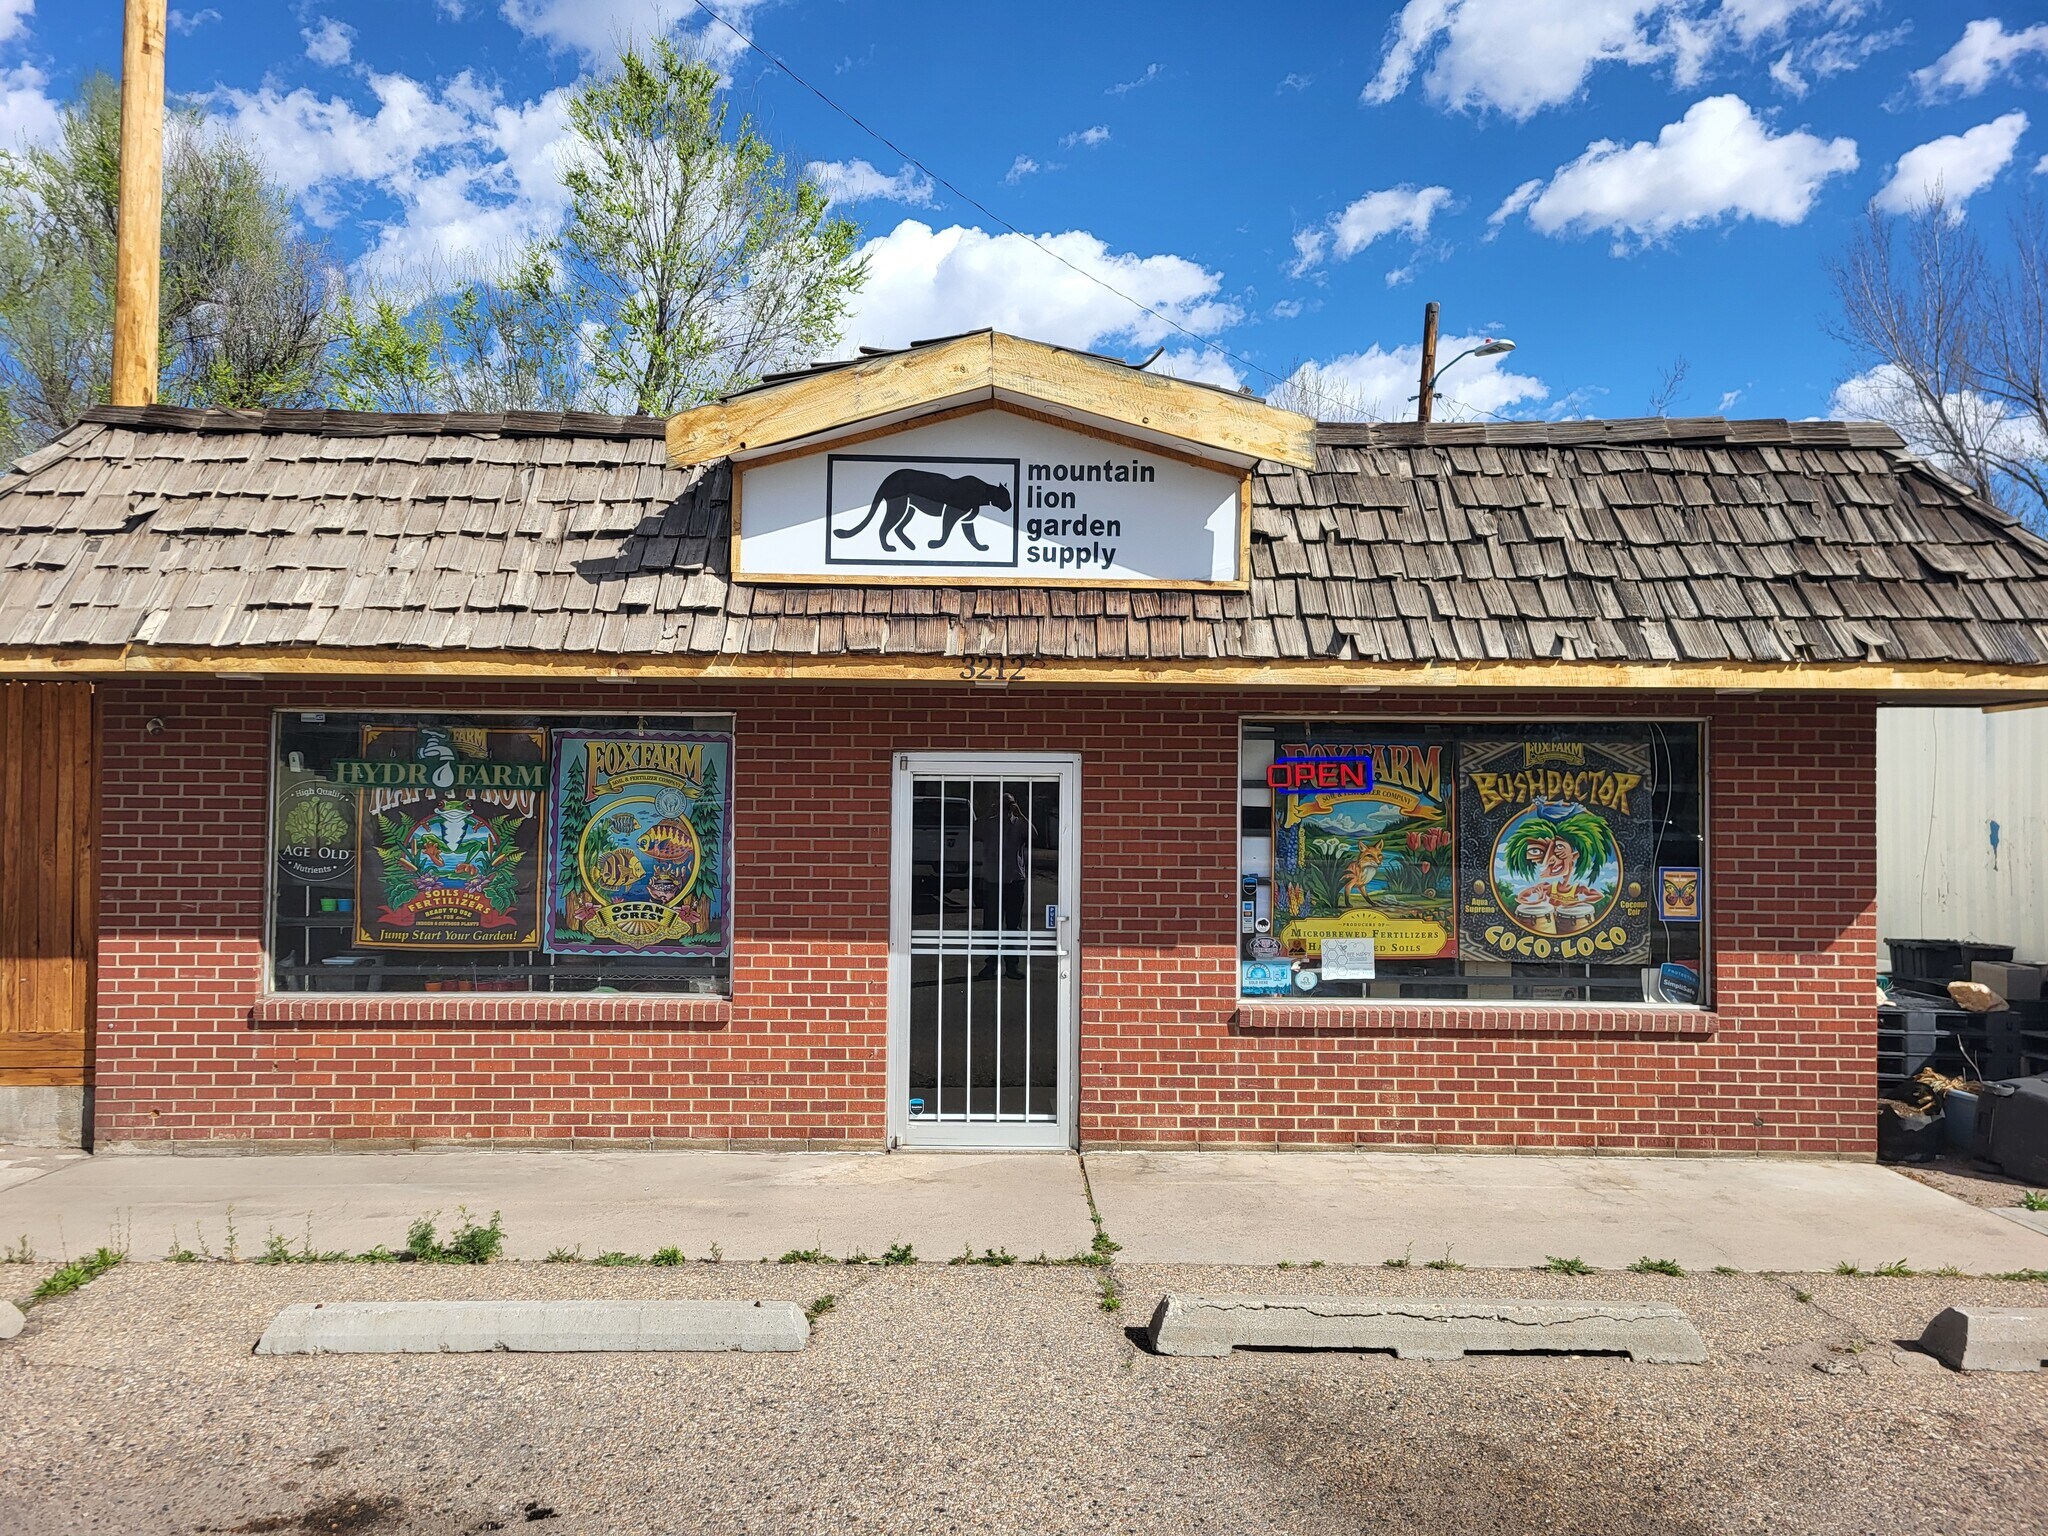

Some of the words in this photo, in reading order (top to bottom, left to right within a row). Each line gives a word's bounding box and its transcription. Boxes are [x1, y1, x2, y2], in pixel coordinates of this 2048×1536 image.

[1028, 460, 1155, 482] mountain
[1027, 485, 1076, 508] lion
[1026, 514, 1121, 541] garden
[1026, 541, 1117, 570] supply
[959, 653, 1026, 680] 3212
[1525, 742, 1583, 763] FOXFARM
[582, 741, 704, 803] FOXFARM
[1267, 762, 1365, 788] OPEN
[612, 778, 624, 786] SOIL
[658, 776, 681, 788] COMPANY
[295, 787, 315, 798] High
[1382, 790, 1413, 805] COMPANY
[283, 844, 311, 857] AGE
[318, 846, 349, 860] OLD
[293, 862, 332, 874] Nutrients
[425, 889, 459, 899] SOILS
[462, 891, 481, 901] and
[1471, 898, 1489, 906] Aqua
[407, 897, 491, 915] FERTILIZERS
[611, 904, 664, 915] OCEAN
[1620, 900, 1648, 909] Coconut
[424, 907, 448, 917] READY
[459, 909, 473, 918] USE
[611, 911, 664, 922] FOREST
[1627, 908, 1641, 916] Coir
[379, 929, 409, 942] Jump
[411, 930, 442, 940] Start
[444, 930, 471, 941] Your
[472, 930, 517, 941] Garden!
[1290, 928, 1368, 938] MICROBREWED
[1372, 929, 1440, 939] FERTILIZERS
[1391, 943, 1421, 952] SOILS
[1667, 968, 1696, 983] PROTECTED
[1663, 979, 1696, 995] SimpliSafe
